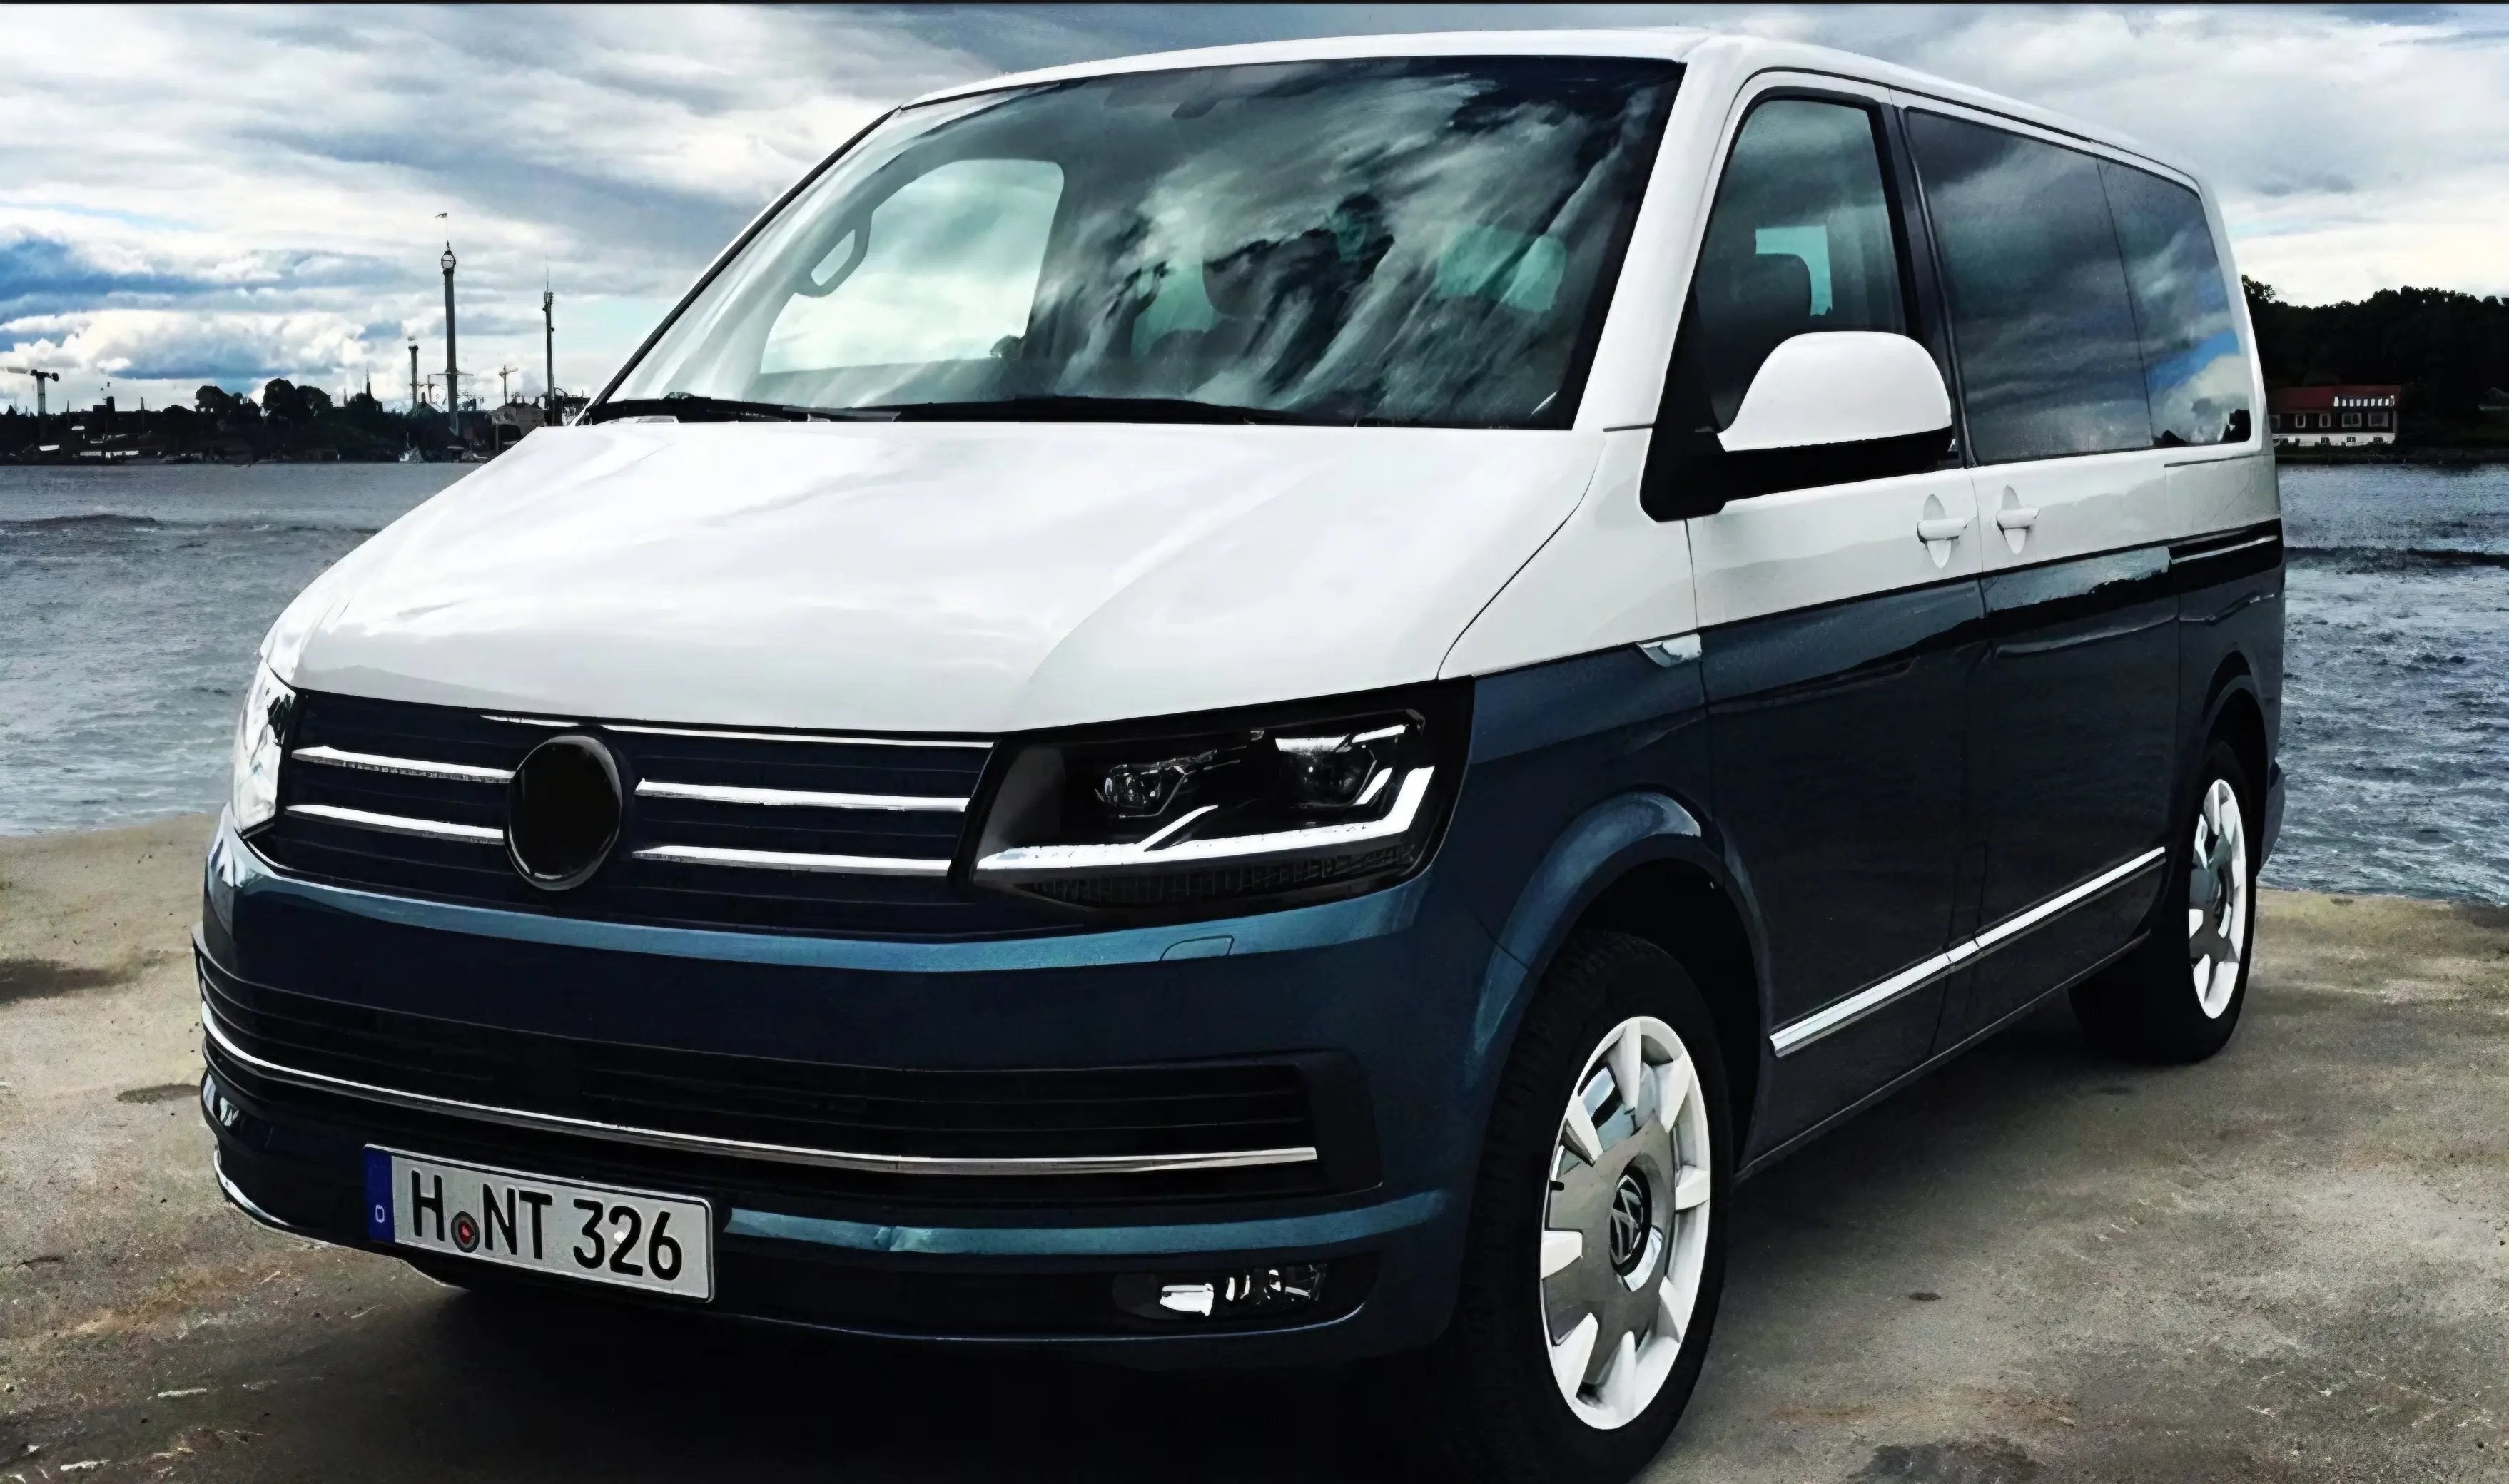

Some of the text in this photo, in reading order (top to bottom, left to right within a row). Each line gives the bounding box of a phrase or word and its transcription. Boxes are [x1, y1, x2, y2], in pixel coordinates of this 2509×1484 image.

[411, 1170, 682, 1281] H NT 326
